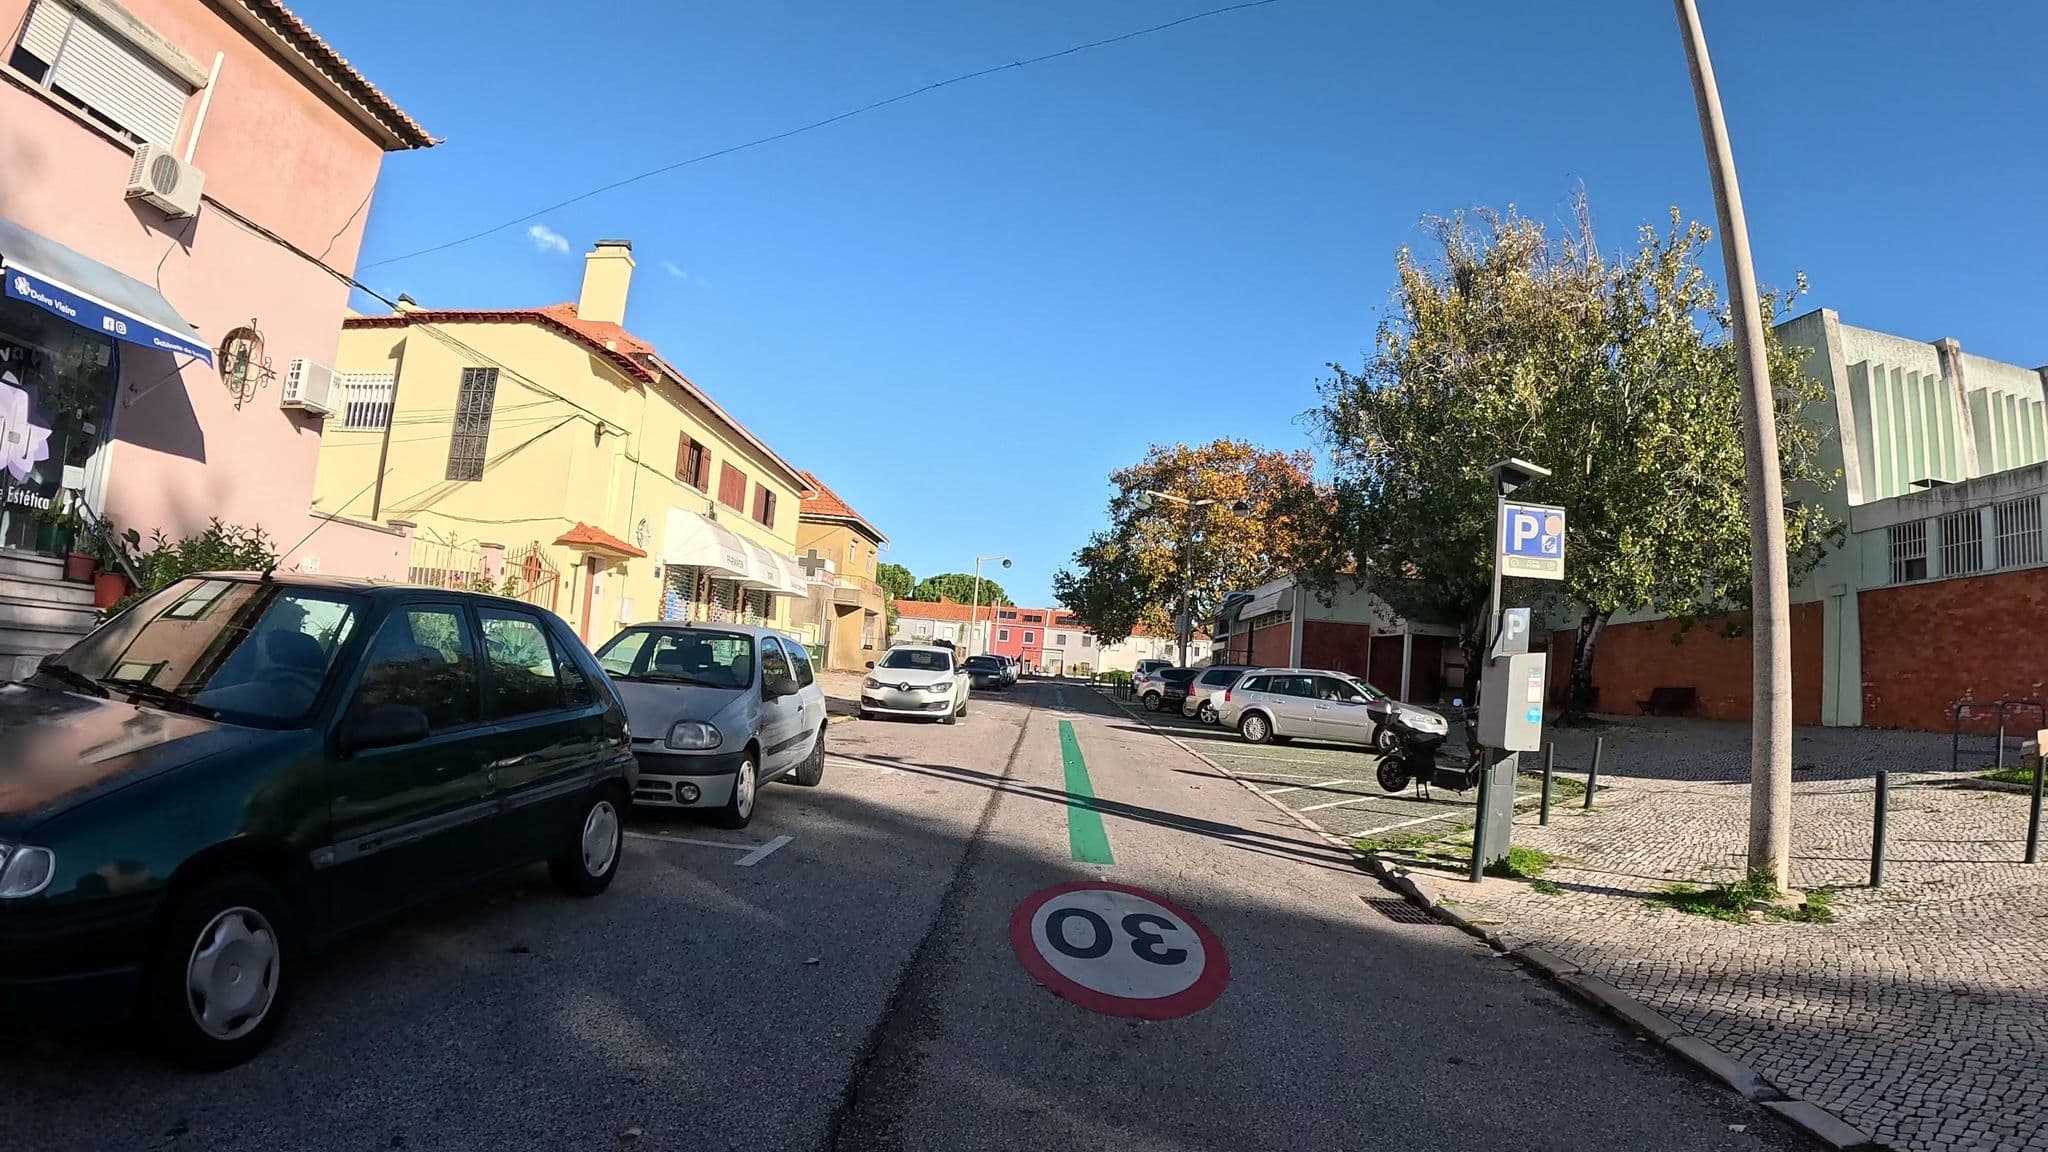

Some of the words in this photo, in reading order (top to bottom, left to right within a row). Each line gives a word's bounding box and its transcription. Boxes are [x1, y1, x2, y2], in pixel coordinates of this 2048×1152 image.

[30, 290, 53, 306] Dalva
[54, 299, 76, 317] Vieira
[7, 485, 50, 510] Estética
[1513, 514, 1539, 551] P
[1507, 614, 1526, 640] P
[1045, 907, 1188, 965] 30
